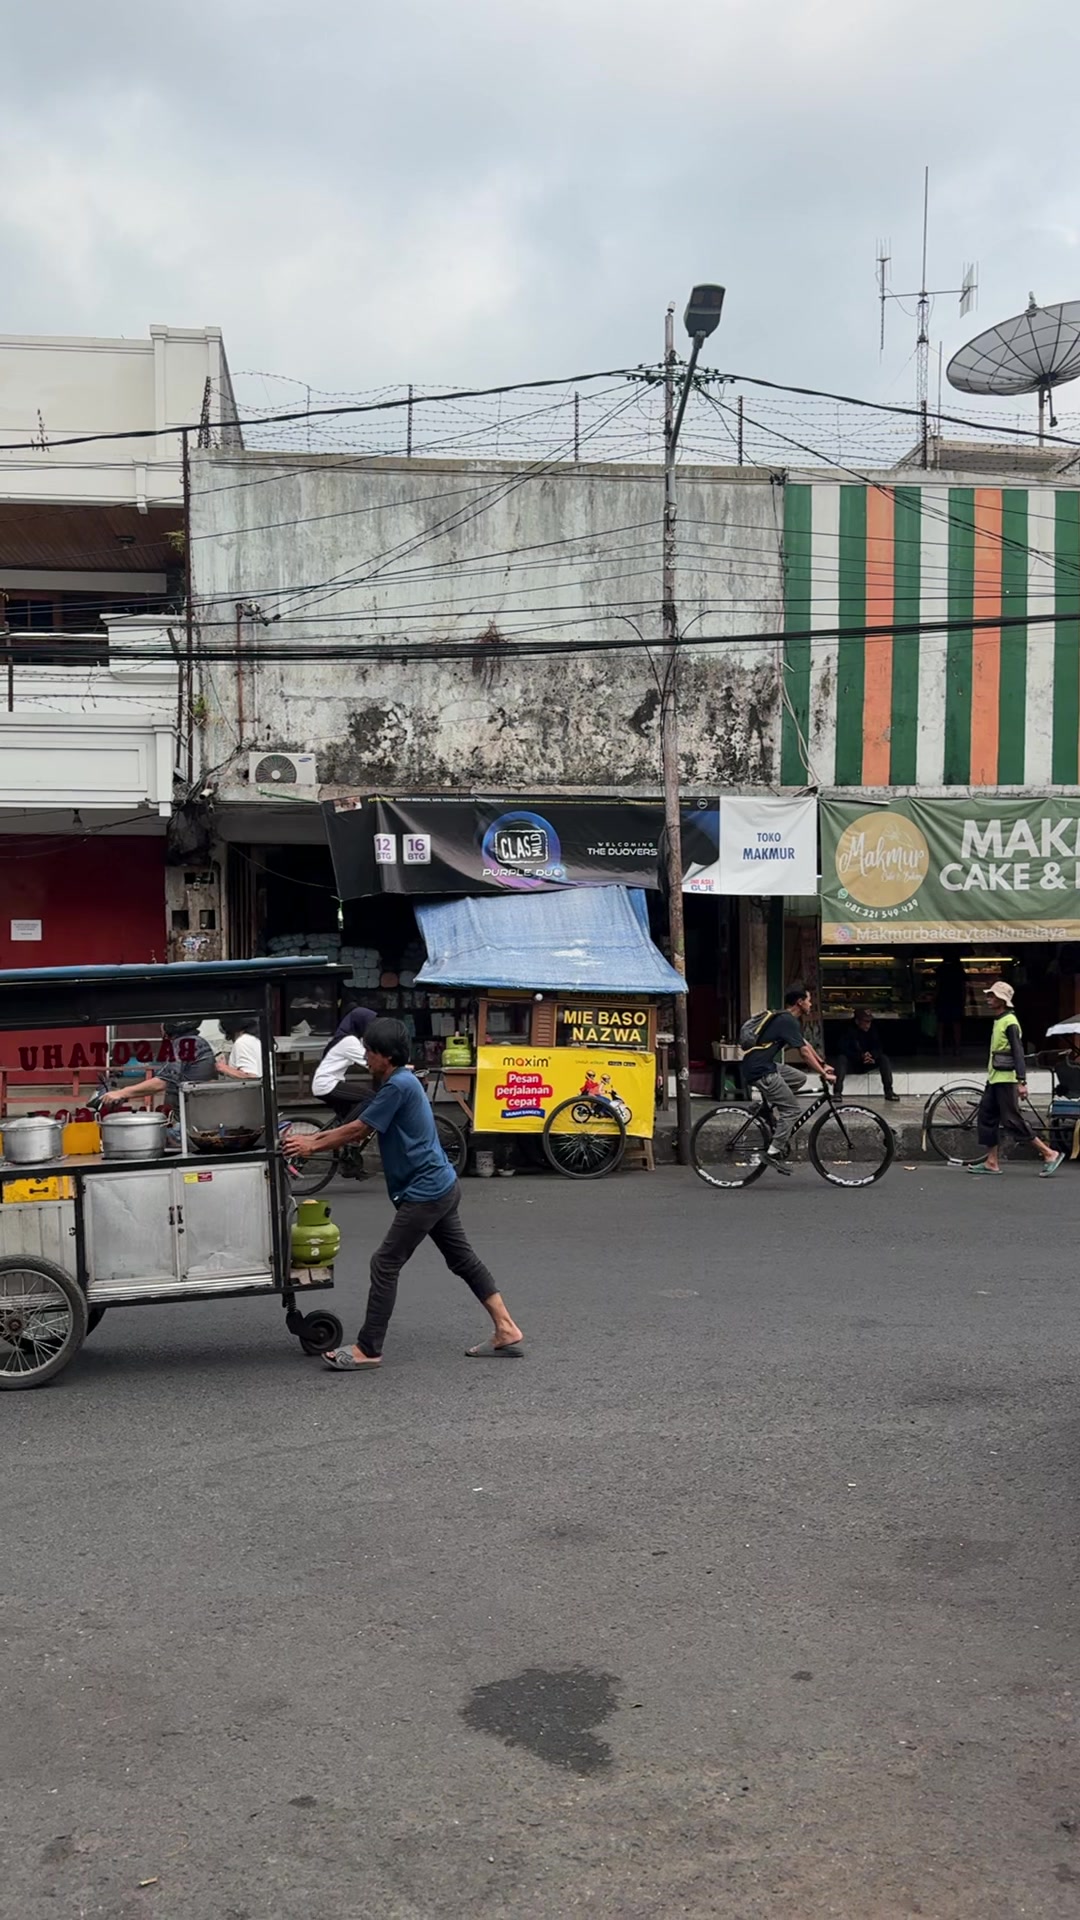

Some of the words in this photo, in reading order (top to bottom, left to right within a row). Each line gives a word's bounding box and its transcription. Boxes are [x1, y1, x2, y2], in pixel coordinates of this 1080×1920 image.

[757, 832, 781, 842] TOKO
[961, 817, 1080, 858] MAK
[376, 838, 391, 851] 12
[408, 838, 425, 851] 16
[500, 836, 532, 859] CLAS
[530, 833, 544, 857] MILD
[742, 848, 795, 860] MAKMUR
[839, 832, 925, 877] Makmur
[482, 868, 533, 877] PURPLE
[939, 862, 1030, 891] CAKE
[1039, 862, 1068, 890] &
[862, 908, 879, 919] 321
[901, 898, 919, 913] 439
[564, 1010, 593, 1025] MIE
[598, 1011, 647, 1026] BASO
[572, 1027, 642, 1043] NAZWA
[503, 1055, 549, 1067] maxim
[509, 1073, 539, 1083] Pesan
[497, 1085, 550, 1097] perjalanan
[508, 1098, 537, 1107] cepat
